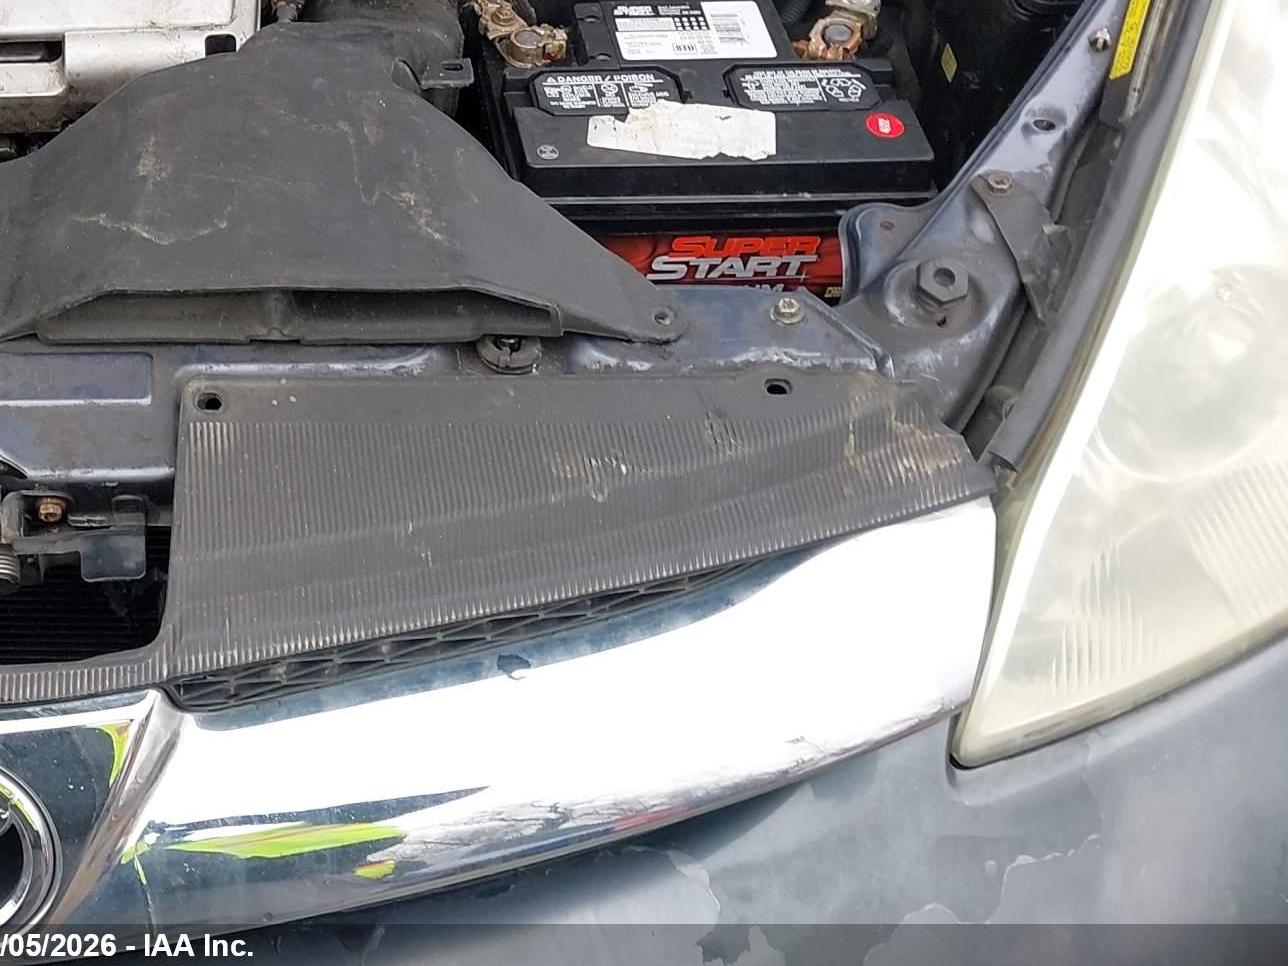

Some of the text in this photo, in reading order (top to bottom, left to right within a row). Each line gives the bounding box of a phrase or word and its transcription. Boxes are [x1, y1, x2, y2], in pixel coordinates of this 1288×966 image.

[557, 74, 602, 84] DANGER
[613, 73, 655, 82] POISON
[668, 235, 821, 257] SUPER
[646, 254, 819, 281] START
